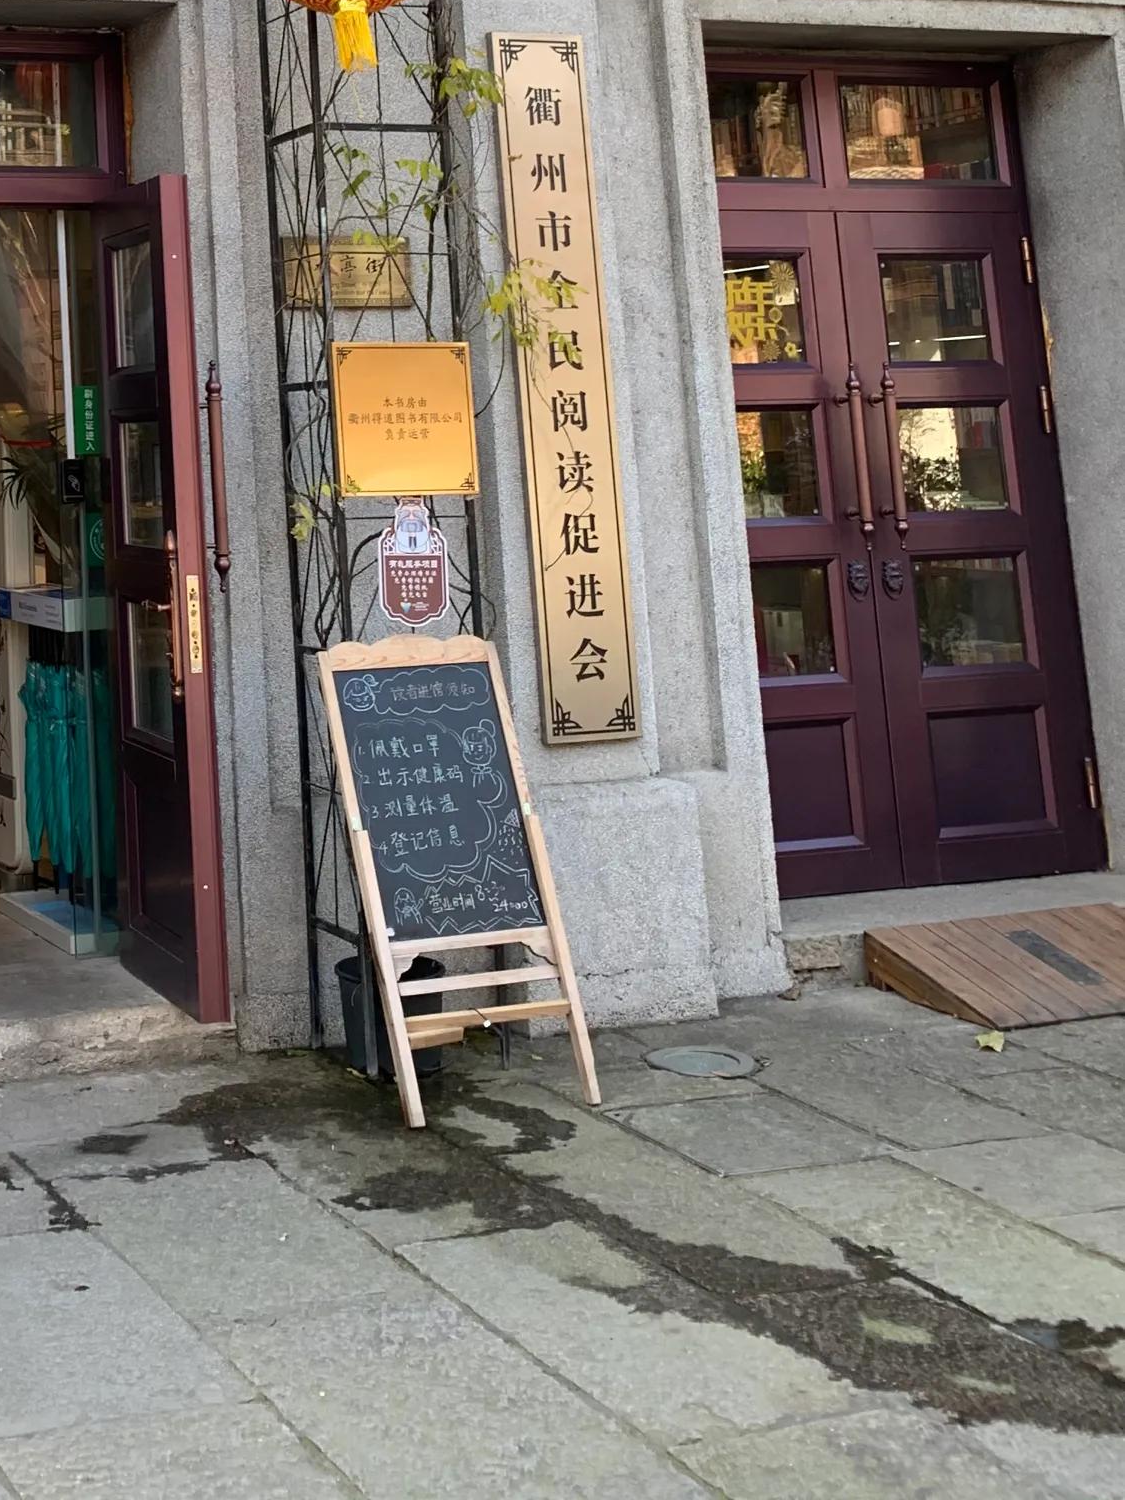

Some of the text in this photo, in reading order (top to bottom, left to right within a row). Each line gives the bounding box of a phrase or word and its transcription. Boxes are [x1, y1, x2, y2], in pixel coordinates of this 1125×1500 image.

[525, 86, 608, 682] 衢州市全民阅读促进会
